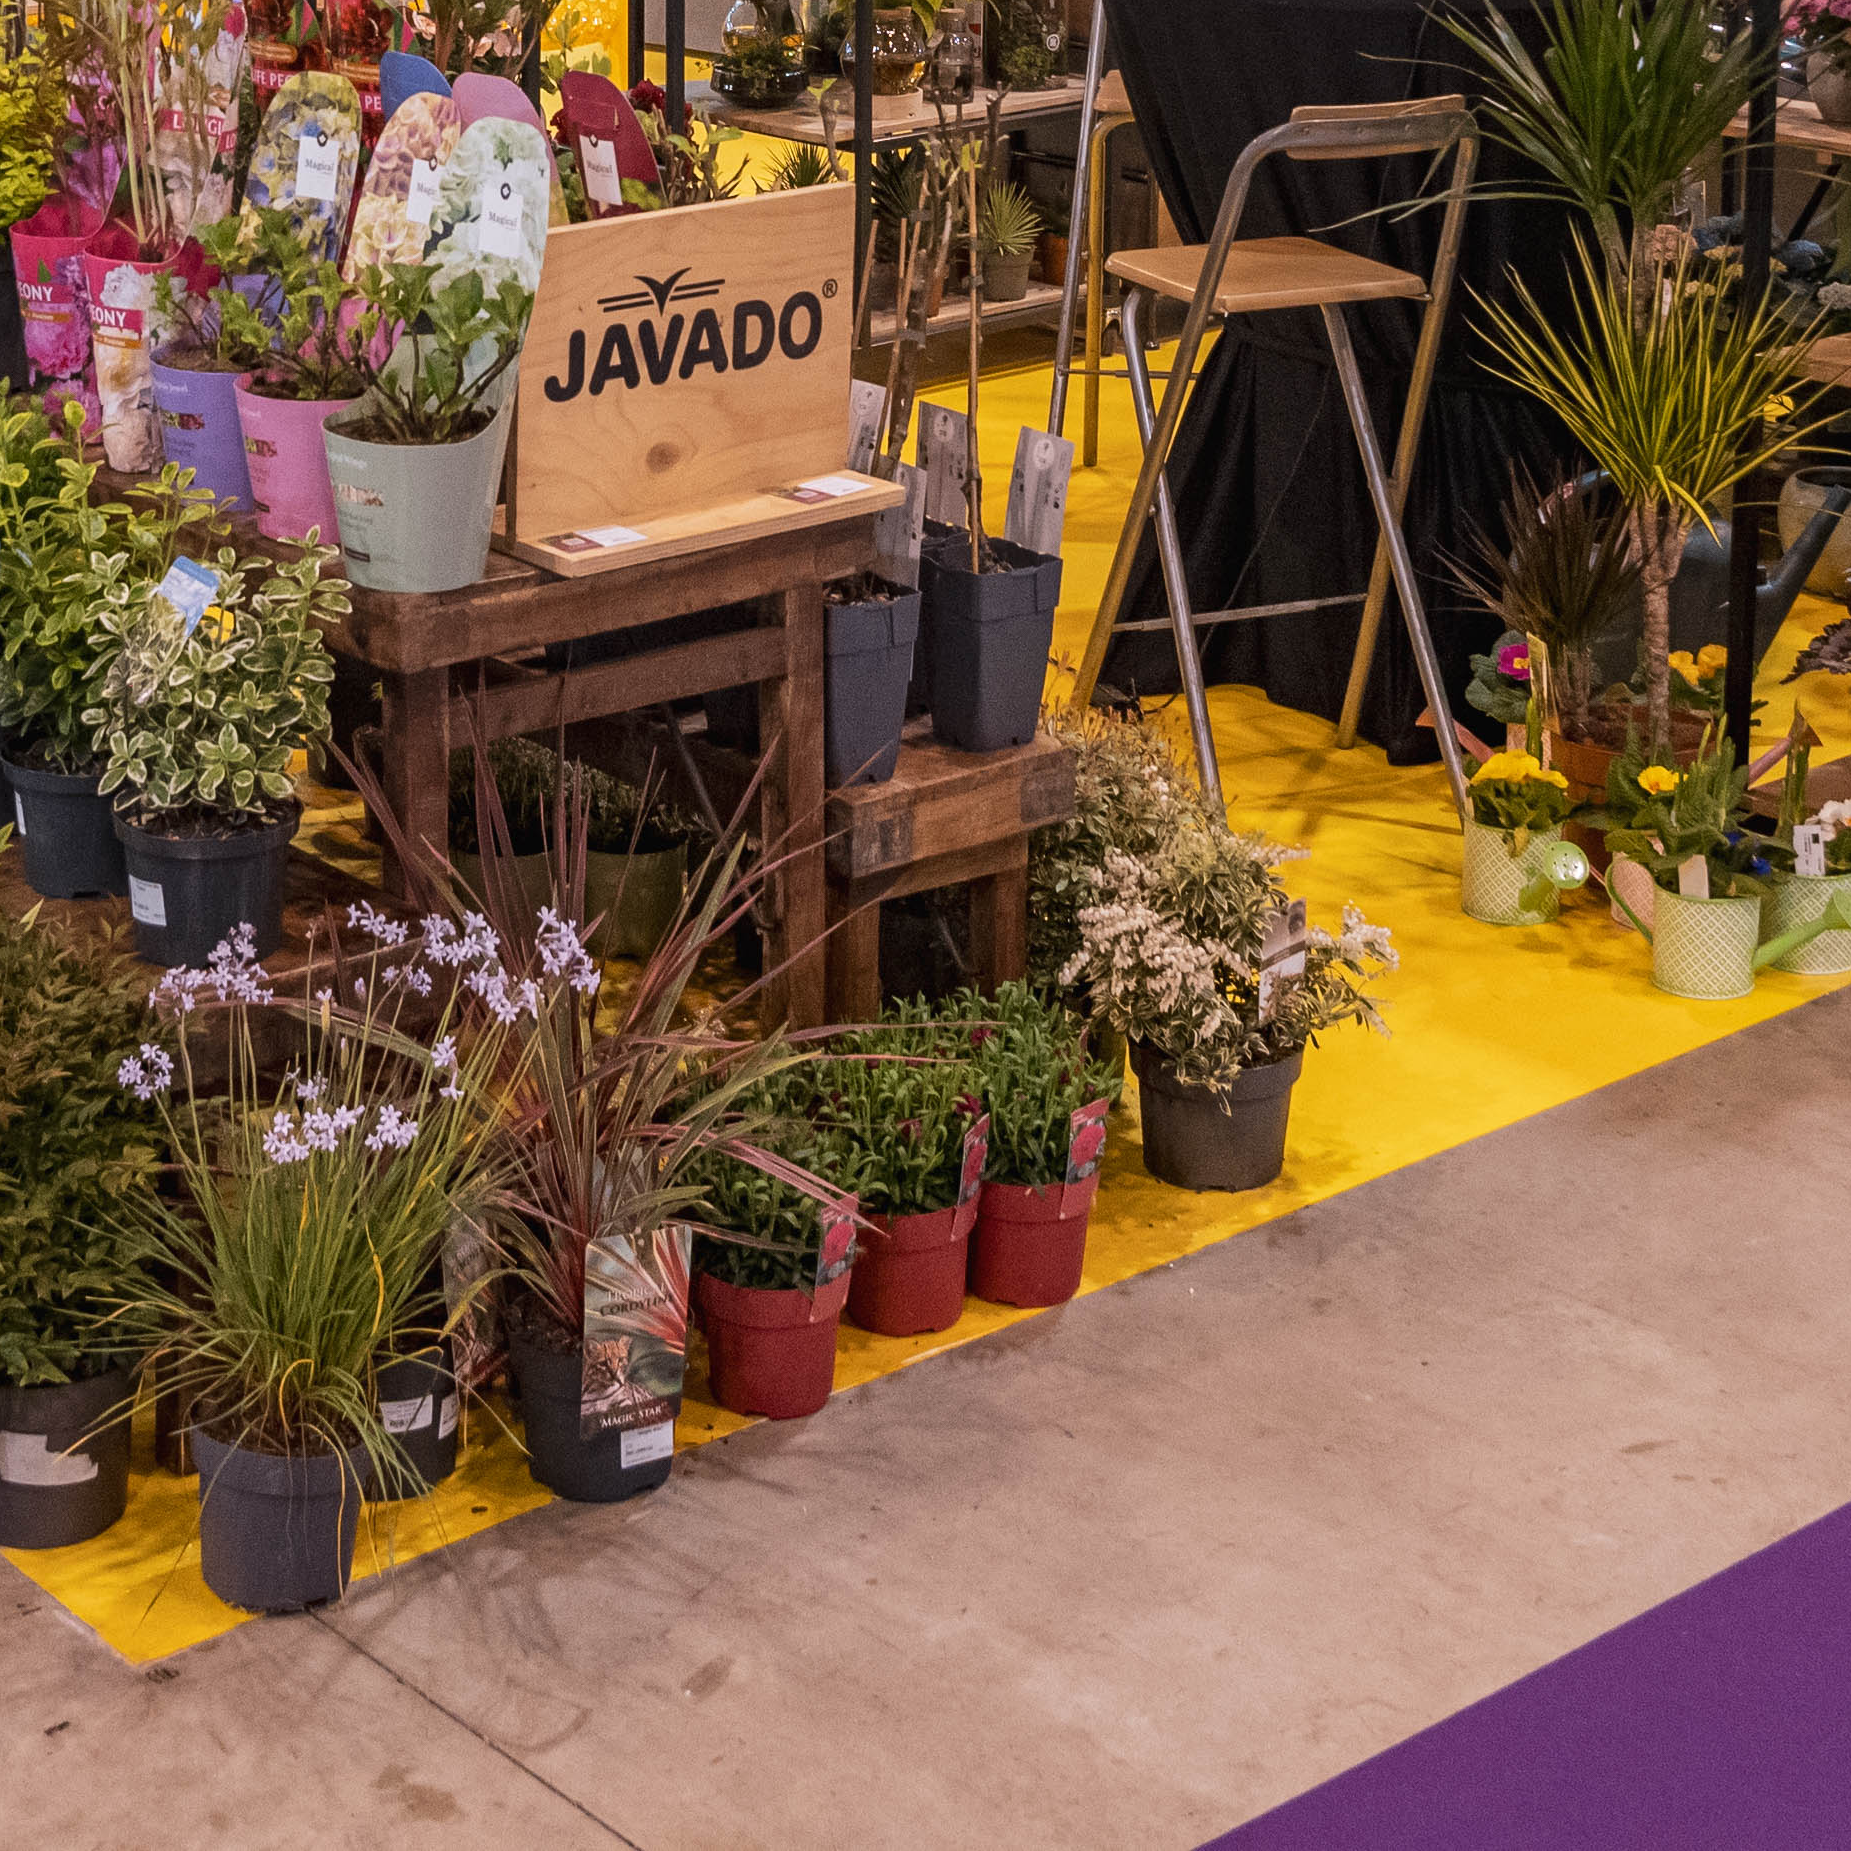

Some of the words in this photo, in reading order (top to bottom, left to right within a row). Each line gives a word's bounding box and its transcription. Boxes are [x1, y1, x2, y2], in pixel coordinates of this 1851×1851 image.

[304, 158, 335, 173] Magical
[488, 211, 518, 227] Magical
[17, 280, 53, 302] EONY
[89, 302, 127, 328] EONY
[545, 289, 826, 404] JAVADO
